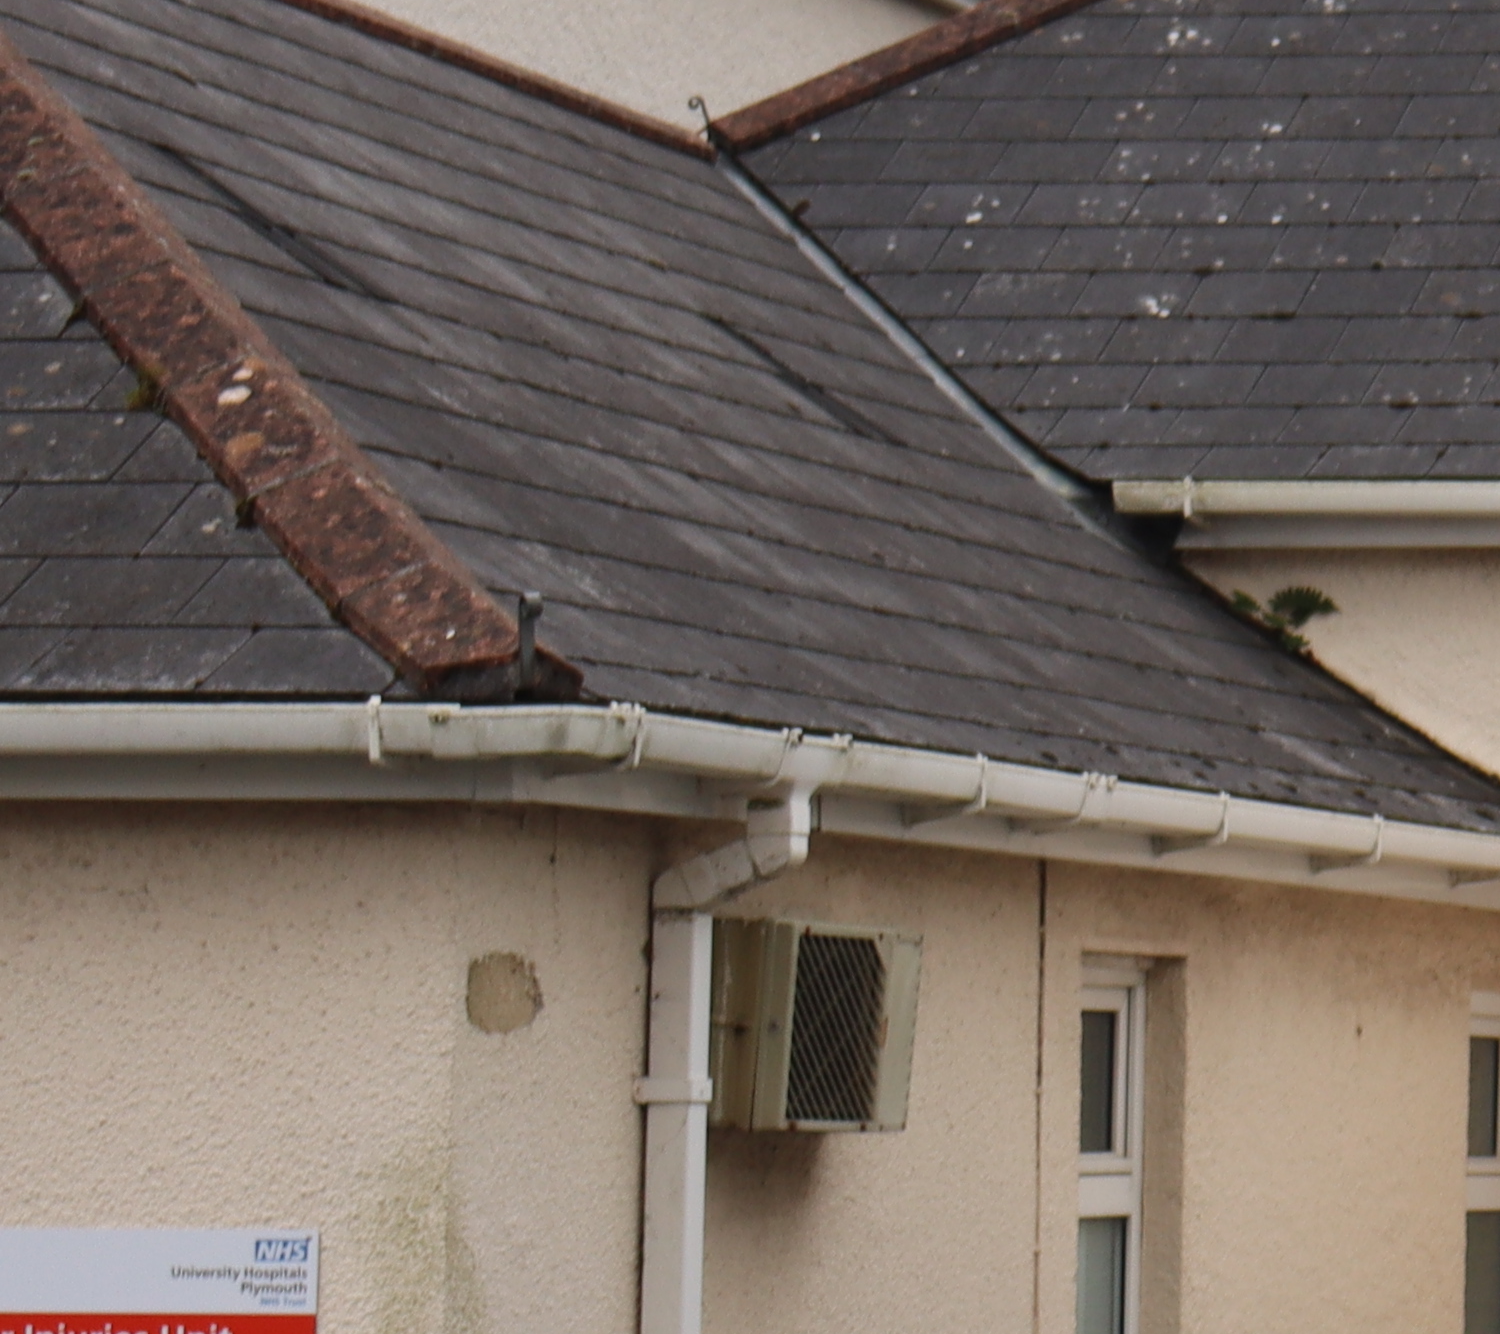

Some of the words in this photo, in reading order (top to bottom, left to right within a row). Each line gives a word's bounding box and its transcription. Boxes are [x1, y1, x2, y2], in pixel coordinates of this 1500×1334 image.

[257, 1241, 307, 1260] NHS
[171, 1267, 240, 1281] University
[244, 1268, 307, 1280] Hospitals
[240, 1282, 307, 1297] Plymouth
